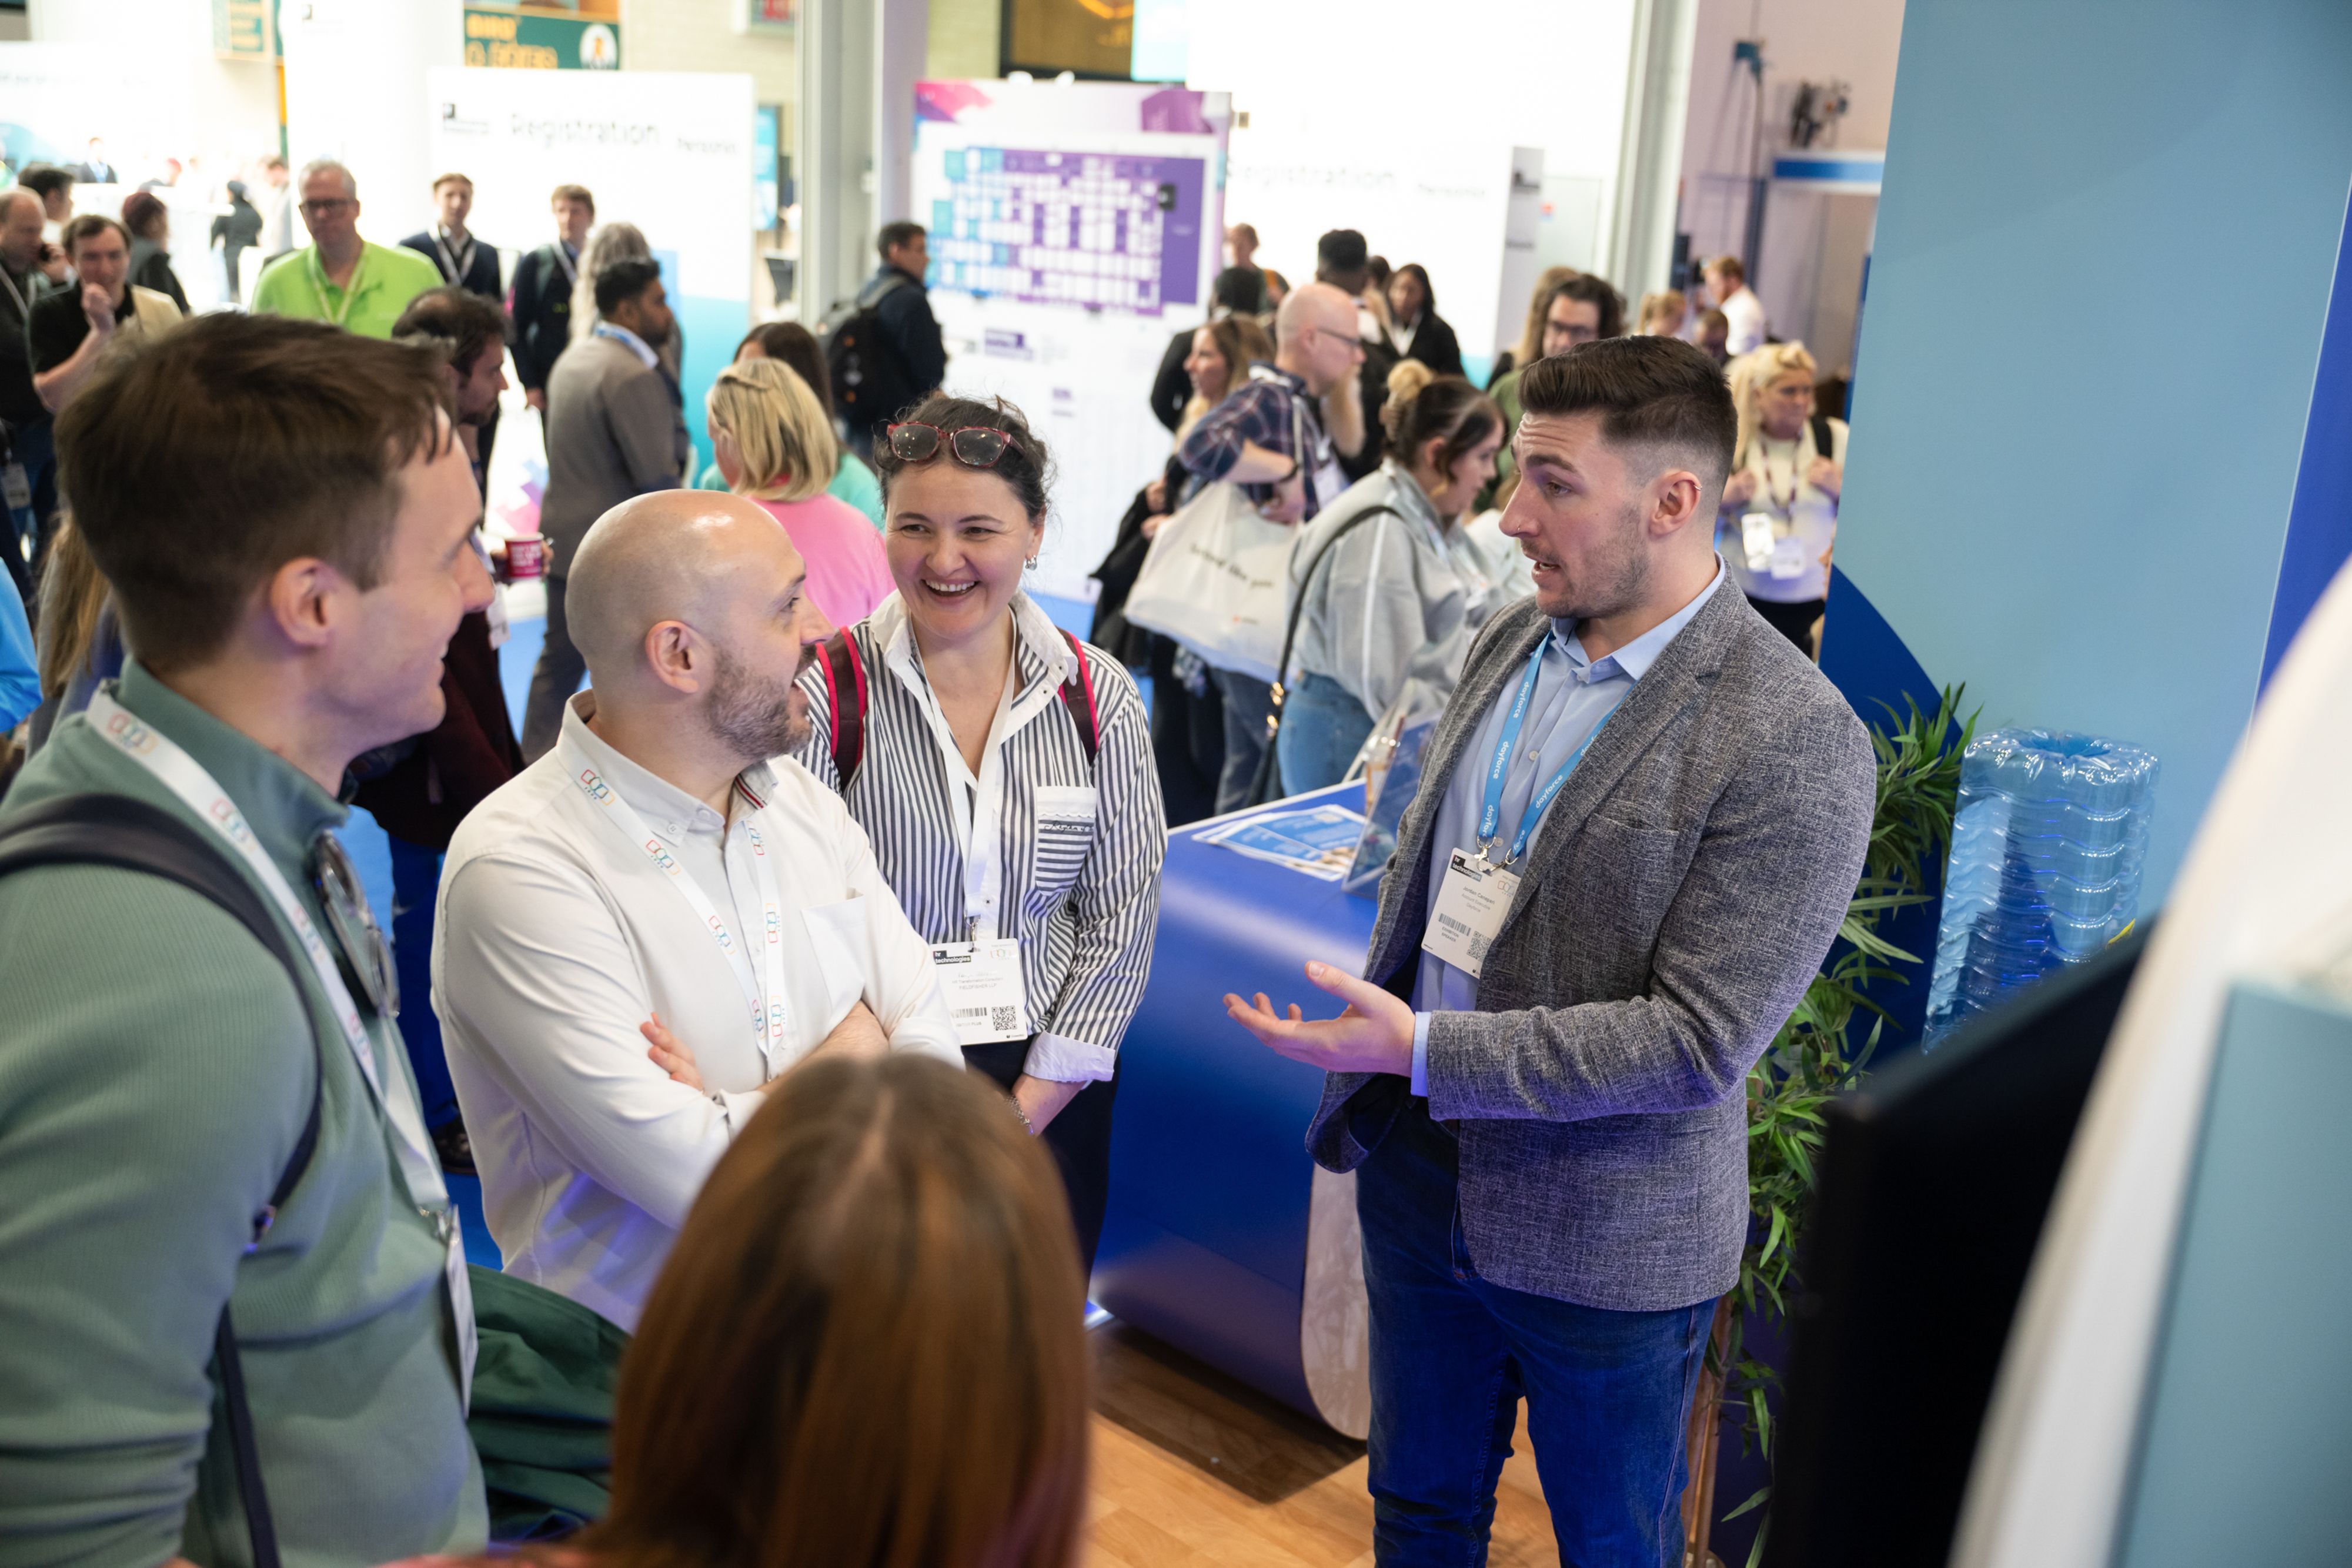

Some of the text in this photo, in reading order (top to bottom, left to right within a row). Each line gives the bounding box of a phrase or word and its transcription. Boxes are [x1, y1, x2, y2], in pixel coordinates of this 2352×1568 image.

[511, 113, 660, 150] Registration
[1514, 682, 1529, 718] dayforce
[1493, 741, 1509, 780] dayforce
[1535, 774, 1563, 808] dayforce
[1514, 830, 1525, 850] force
